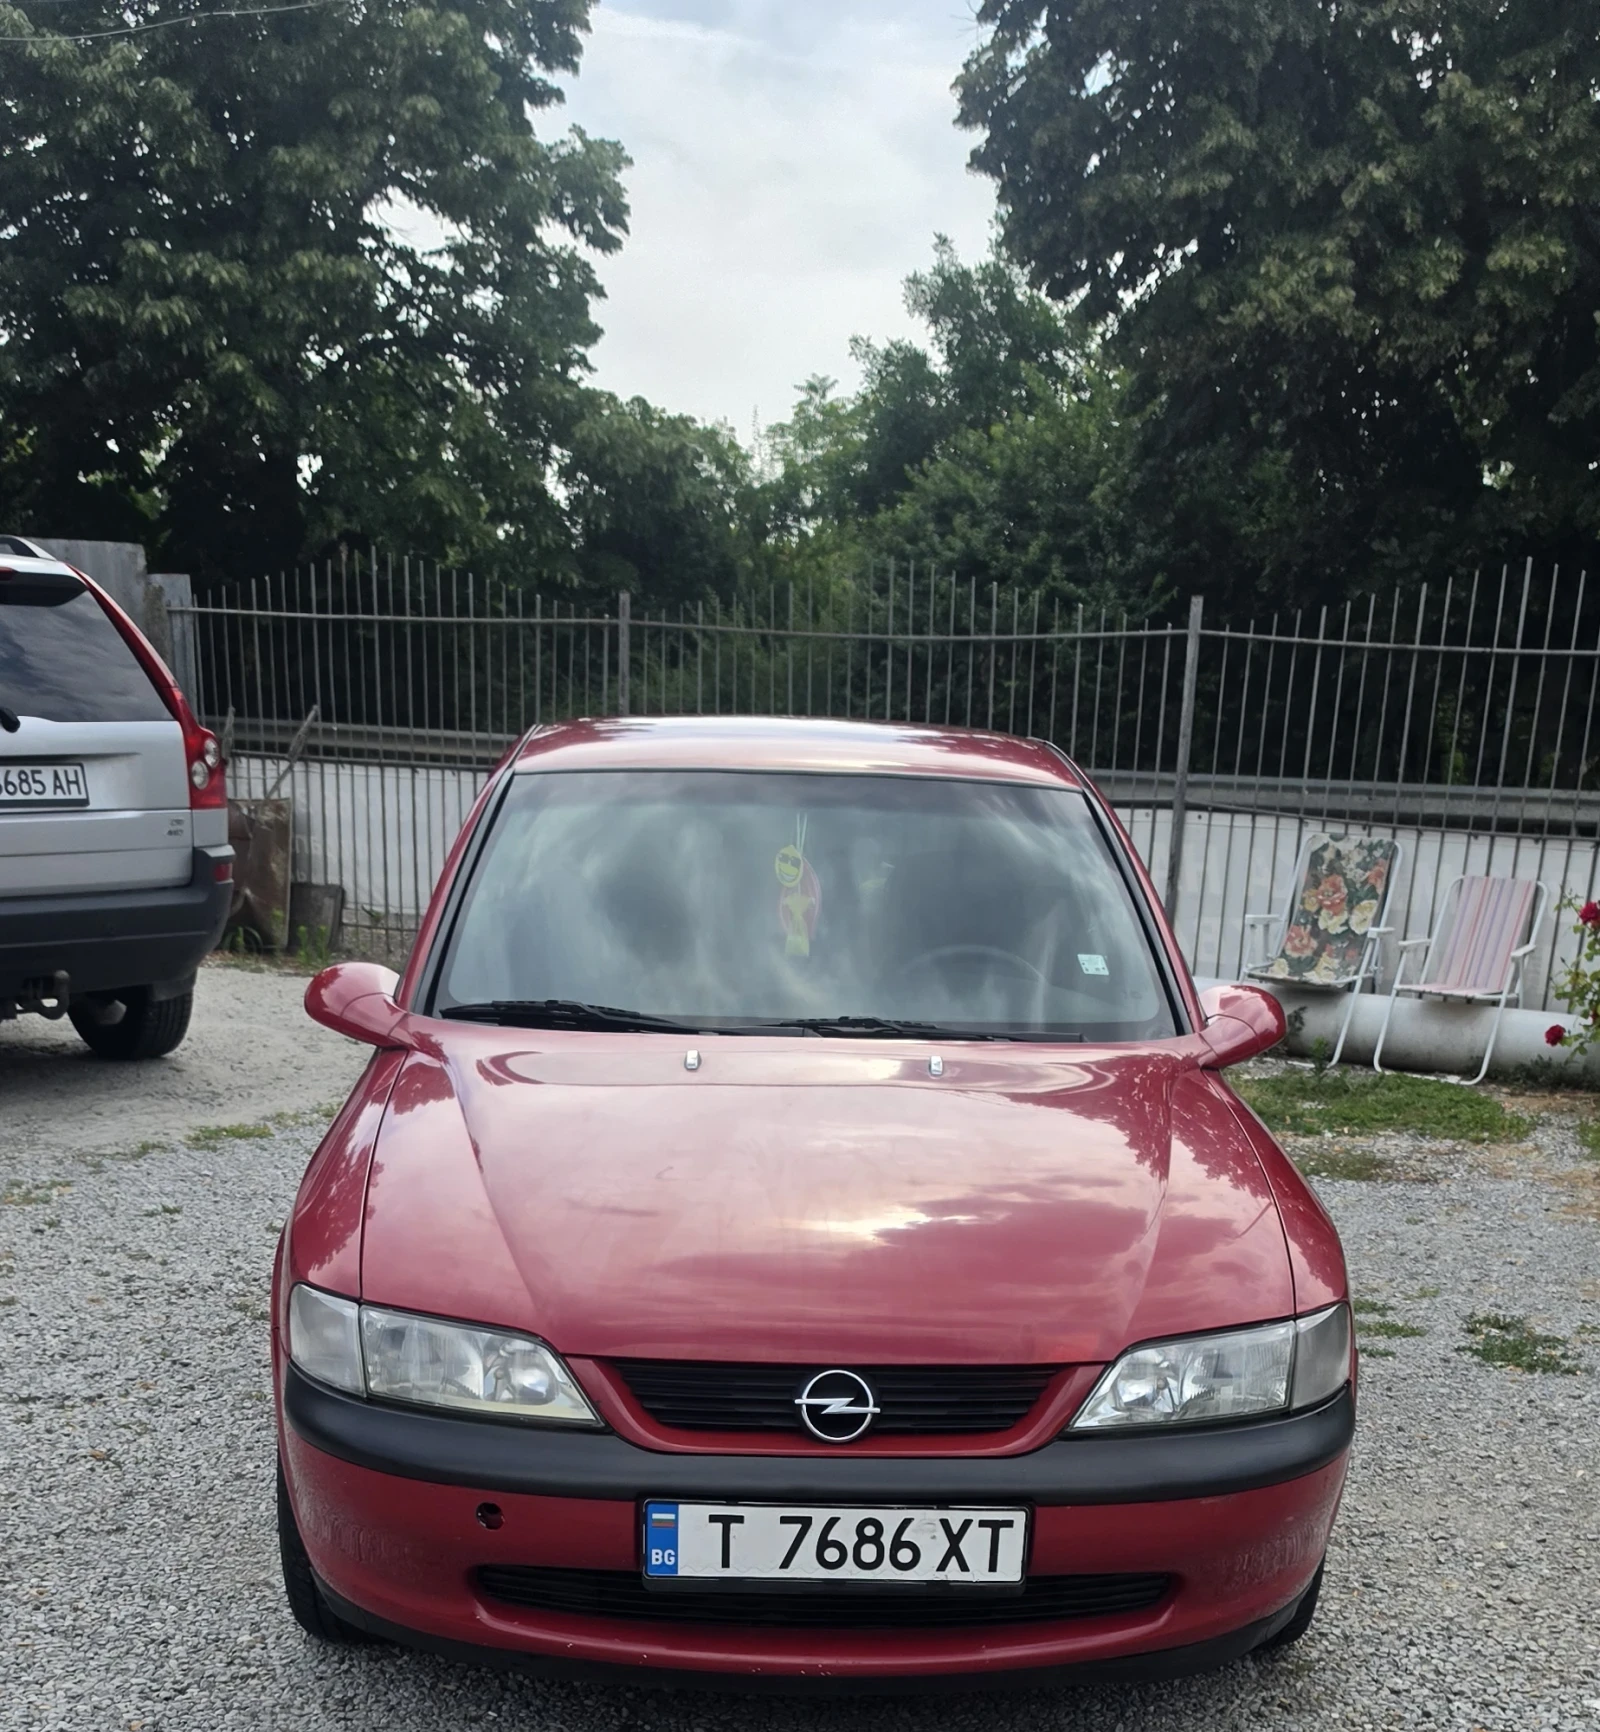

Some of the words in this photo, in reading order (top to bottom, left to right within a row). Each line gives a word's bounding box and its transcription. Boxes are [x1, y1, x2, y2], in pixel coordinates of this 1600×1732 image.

[0, 769, 46, 796] 685
[53, 769, 82, 795] AH
[652, 1549, 675, 1565] BG
[708, 1514, 745, 1568] T
[779, 1515, 921, 1571] 7686
[936, 1518, 1014, 1573] XT
